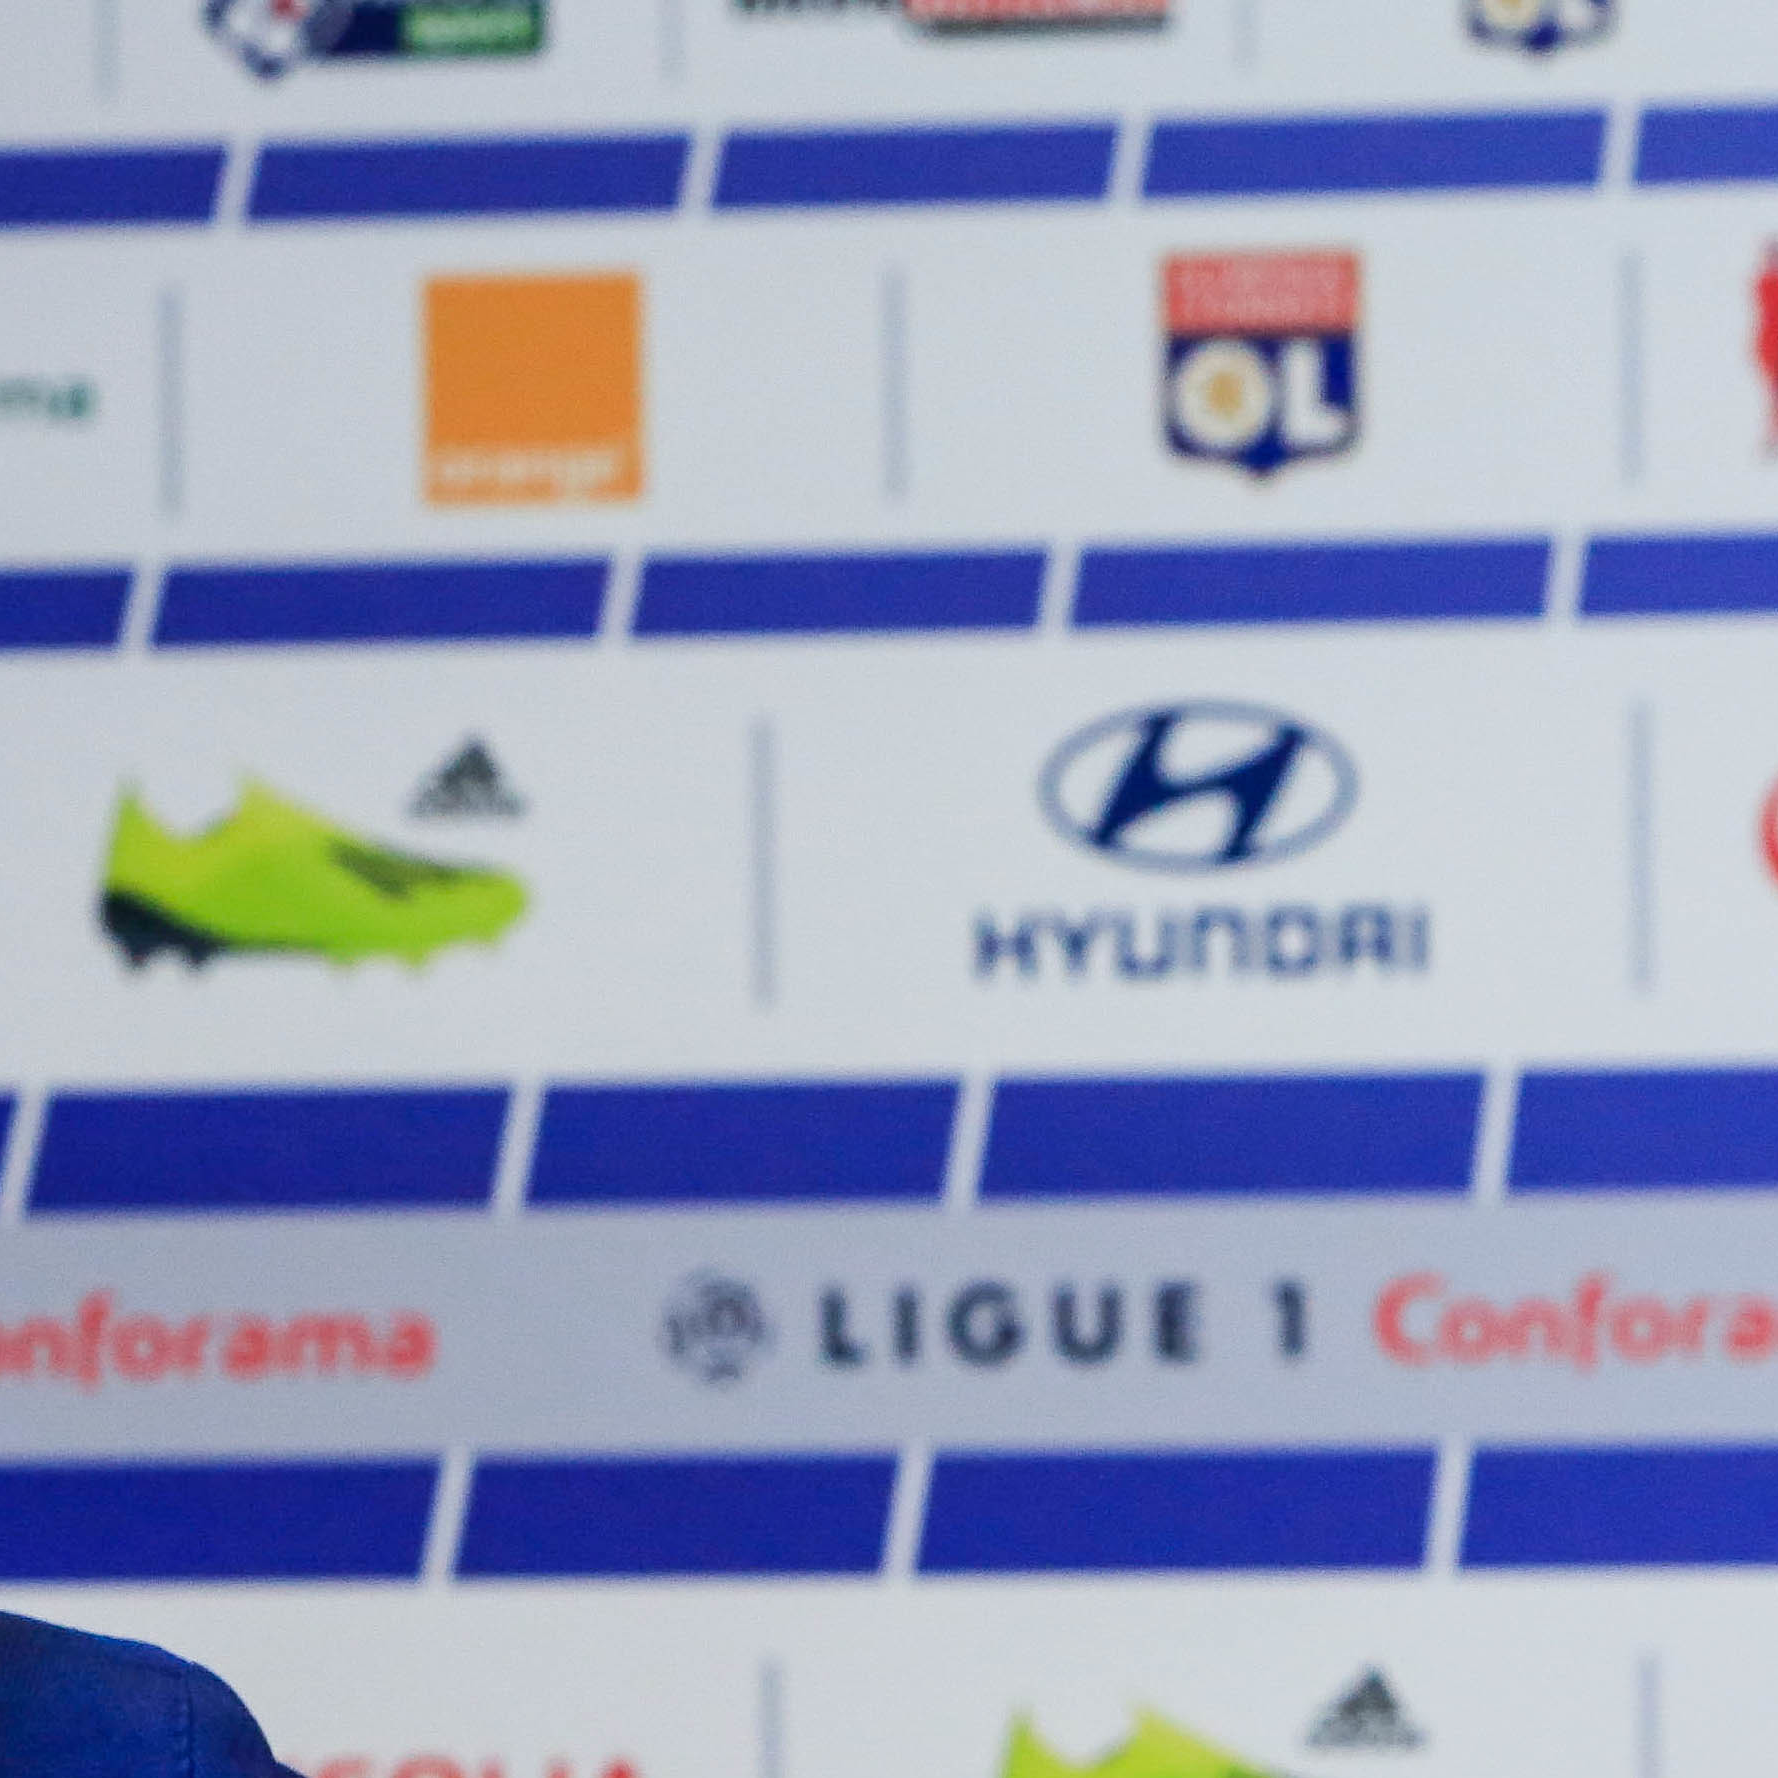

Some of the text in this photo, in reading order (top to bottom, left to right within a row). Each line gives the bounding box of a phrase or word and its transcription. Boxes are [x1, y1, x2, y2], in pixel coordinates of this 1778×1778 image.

[1175, 338, 1352, 446] OL
[972, 902, 1430, 982] HYUNDAI
[818, 1280, 1198, 1370] LIGUE
[1270, 1278, 1310, 1360] 1
